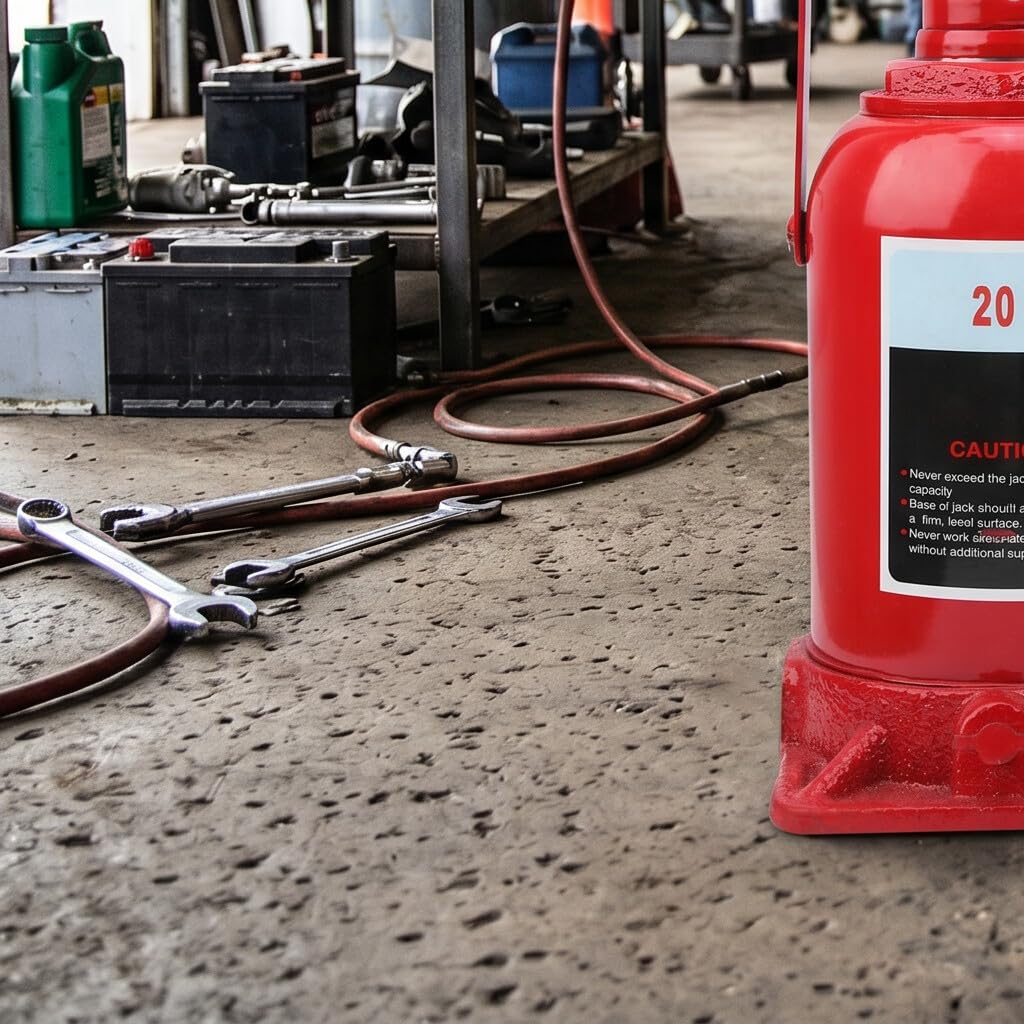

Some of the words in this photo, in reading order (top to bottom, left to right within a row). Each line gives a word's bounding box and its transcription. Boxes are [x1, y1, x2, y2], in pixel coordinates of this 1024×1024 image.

[971, 285, 1015, 328] 20
[909, 468, 942, 481] Never
[944, 472, 985, 484] exceed
[987, 473, 1006, 484] the
[909, 484, 953, 498] capacity
[909, 498, 936, 511] Base
[939, 501, 949, 511] of
[951, 502, 975, 514] jack
[908, 515, 916, 524] a
[909, 528, 940, 540] Never
[942, 530, 969, 543] work
[908, 544, 947, 556] without
[949, 546, 1005, 559] additional
